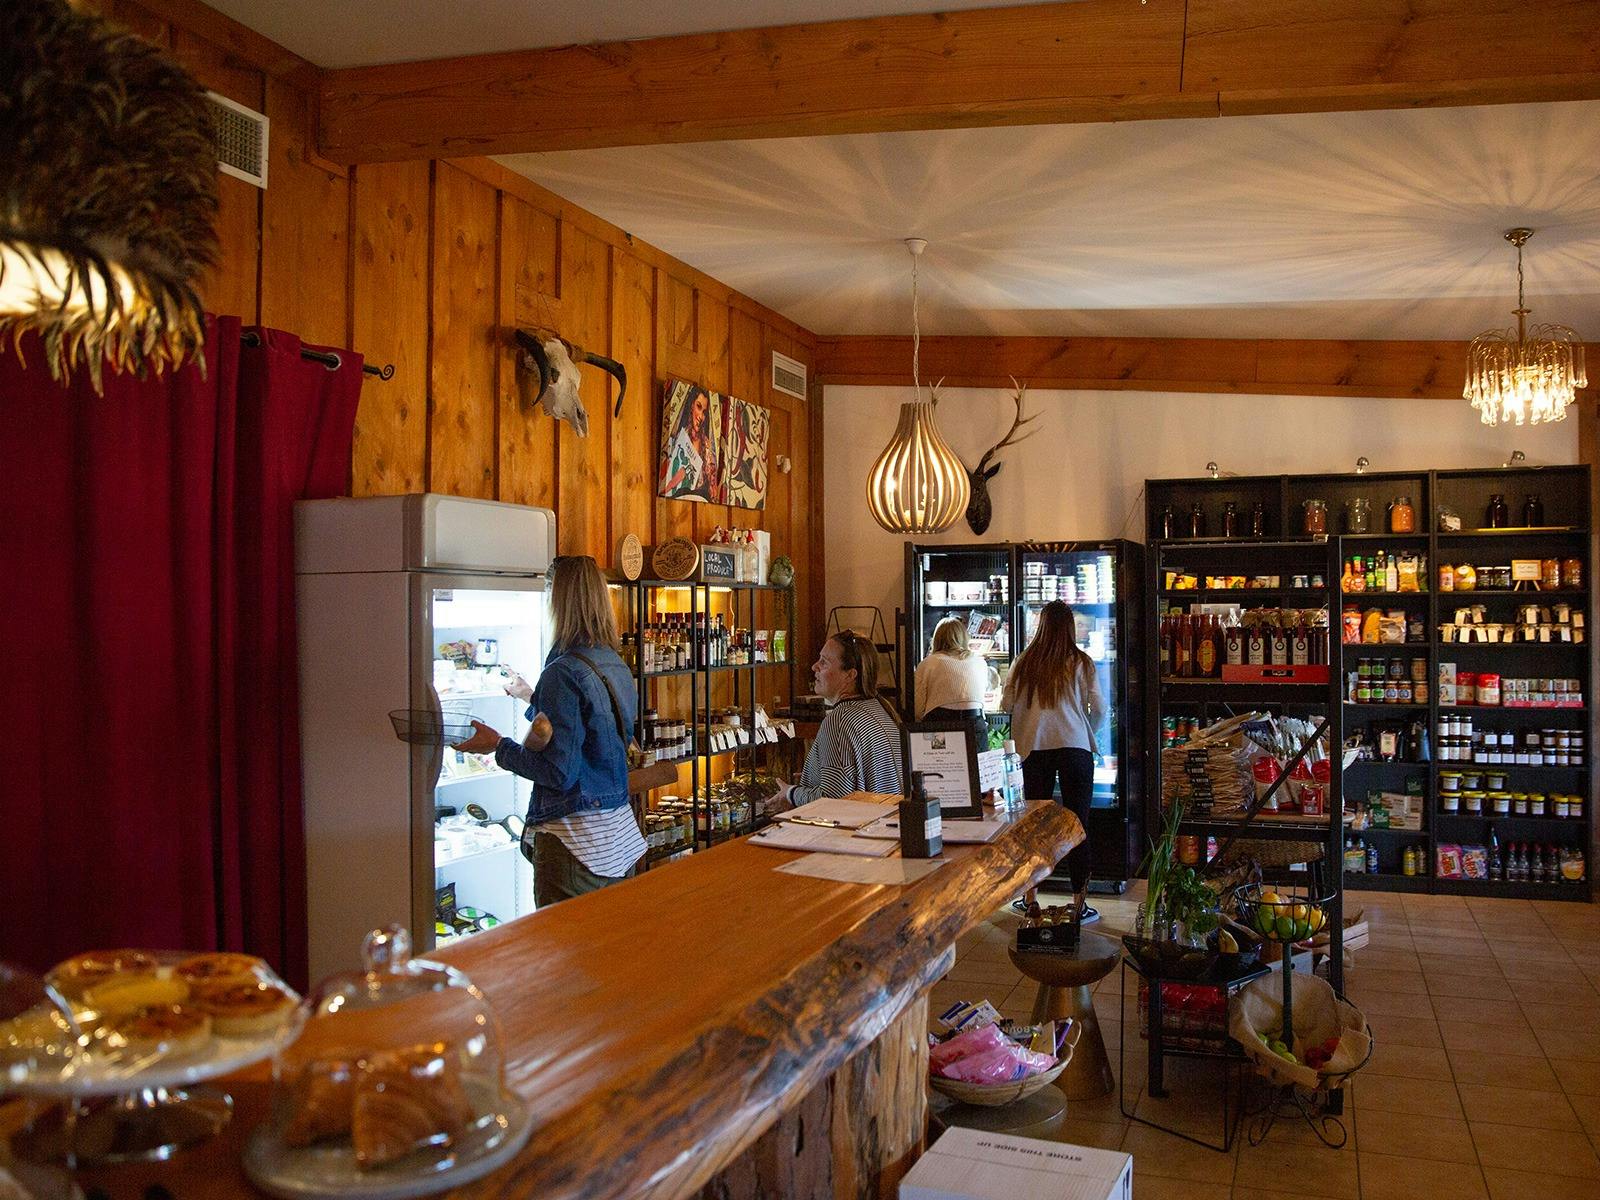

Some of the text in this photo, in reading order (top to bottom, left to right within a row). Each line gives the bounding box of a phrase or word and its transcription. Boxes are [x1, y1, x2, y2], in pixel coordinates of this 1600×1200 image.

[705, 553, 722, 564] LOCAL
[993, 1143, 1018, 1153] SIDE
[1019, 1148, 1043, 1157] THIS
[1046, 1151, 1083, 1162] STORE
